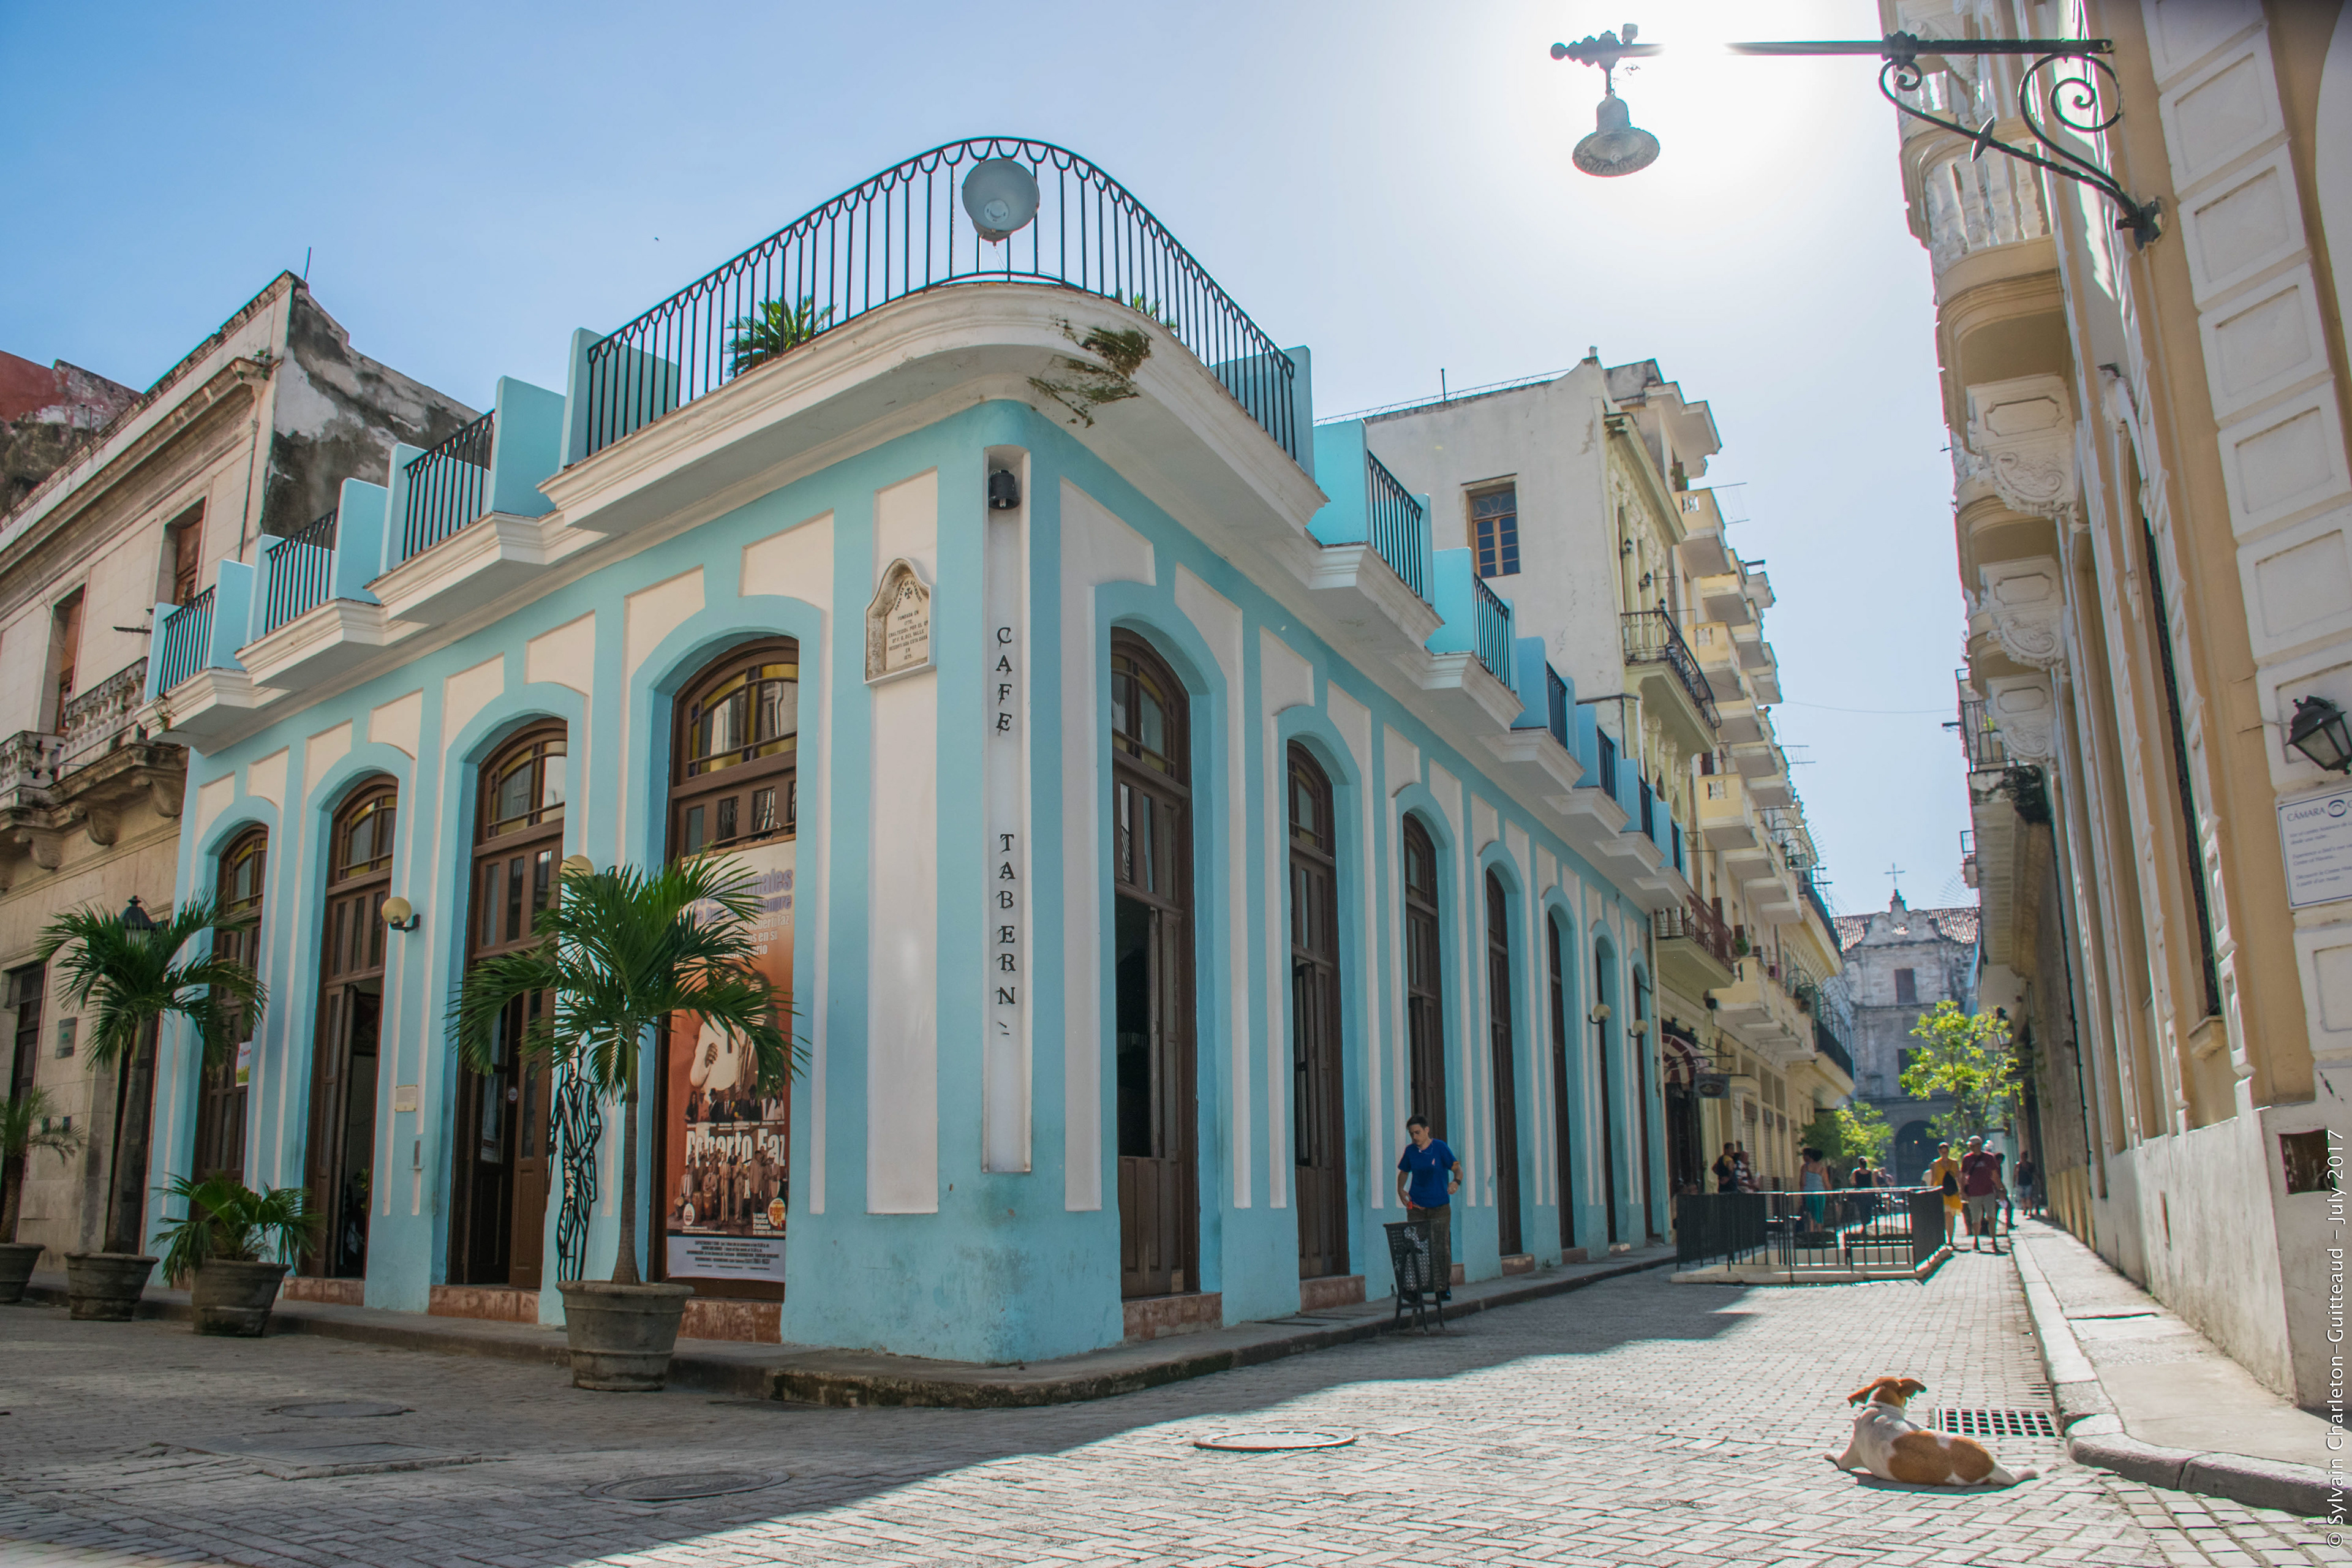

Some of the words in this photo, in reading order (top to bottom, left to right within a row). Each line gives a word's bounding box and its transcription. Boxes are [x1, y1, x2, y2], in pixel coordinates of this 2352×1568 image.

[996, 627, 1012, 731] CAFE
[777, 914, 790, 926] Faz
[758, 930, 769, 943] en
[757, 1128, 786, 1167] Faz
